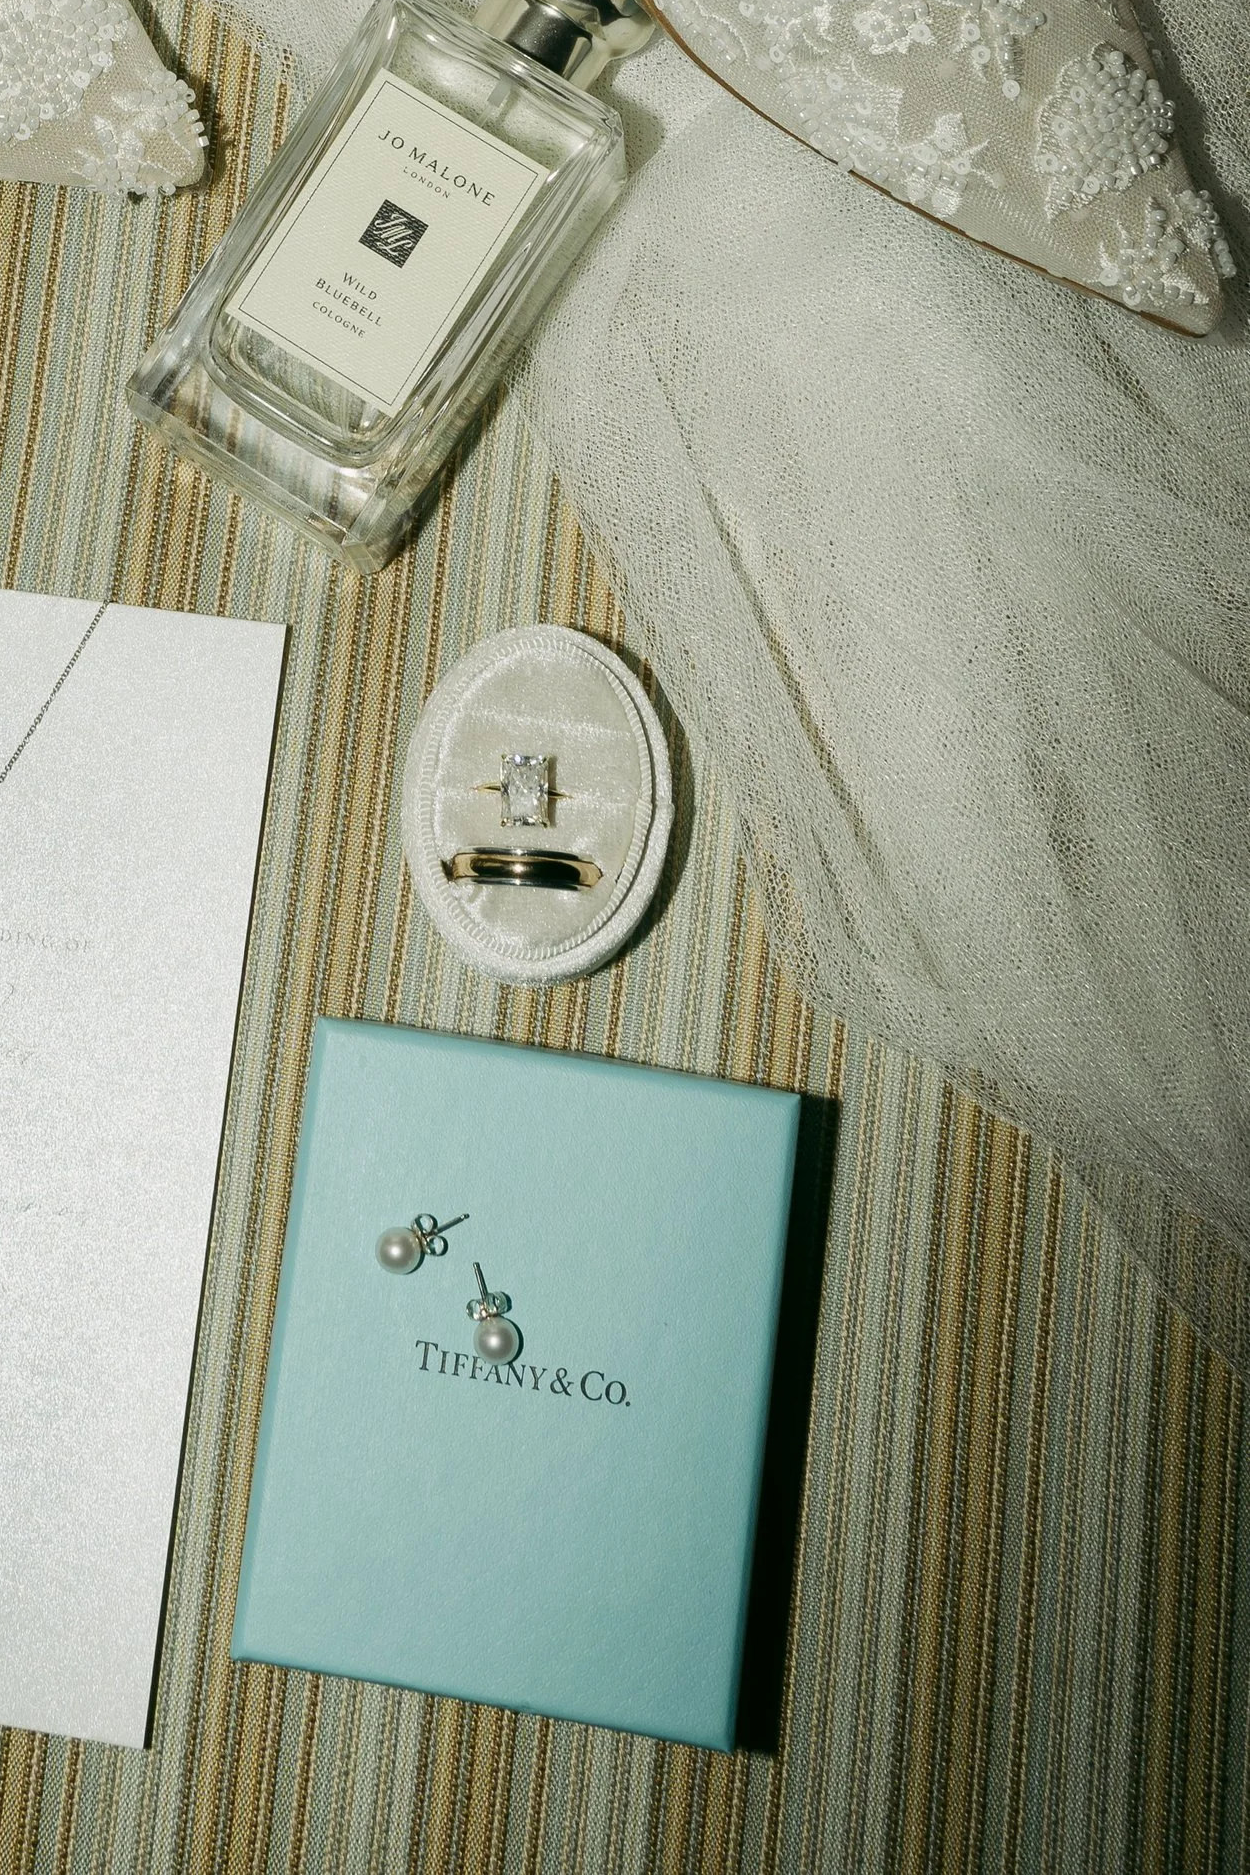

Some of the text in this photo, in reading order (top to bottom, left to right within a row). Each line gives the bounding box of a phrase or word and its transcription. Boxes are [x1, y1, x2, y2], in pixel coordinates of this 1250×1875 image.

[377, 129, 496, 206] JO MALONE
[402, 166, 451, 199] LONDON
[314, 277, 383, 327] BLUEBELL
[342, 272, 378, 301] WILD
[311, 301, 366, 339] COLOGNE
